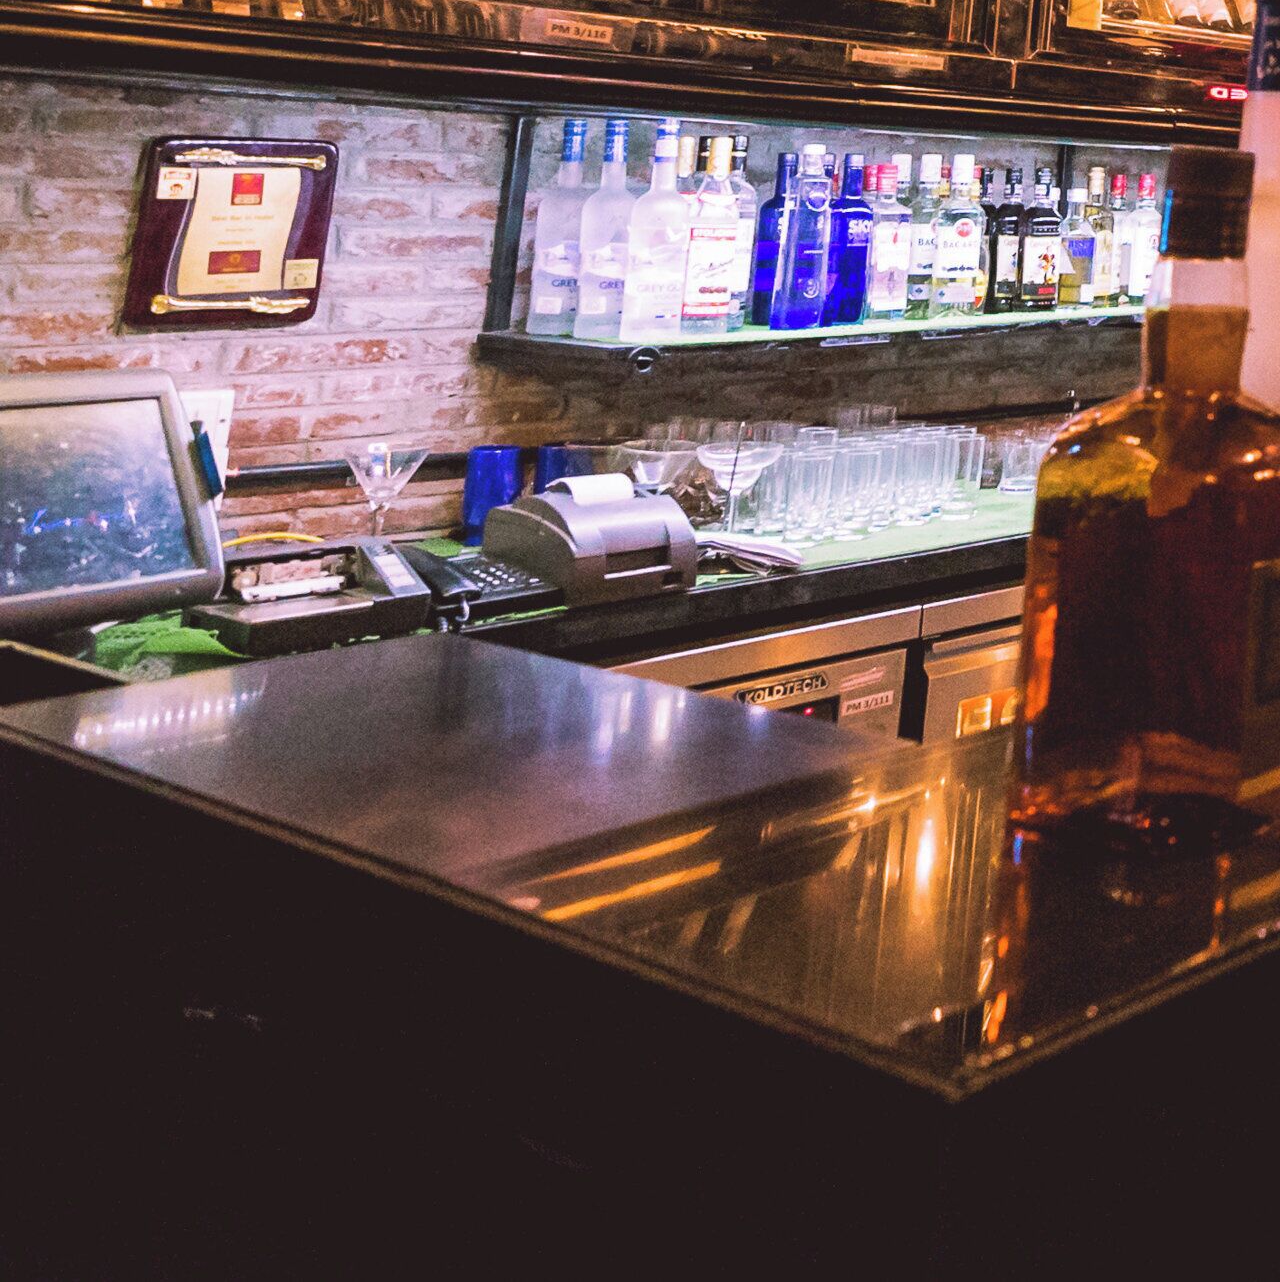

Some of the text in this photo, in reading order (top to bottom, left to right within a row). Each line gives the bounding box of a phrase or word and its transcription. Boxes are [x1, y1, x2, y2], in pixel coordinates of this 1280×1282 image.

[551, 24, 607, 39] PM 3/116
[744, 675, 823, 705] KOLDTECH
[846, 694, 890, 713] PM 3/111
